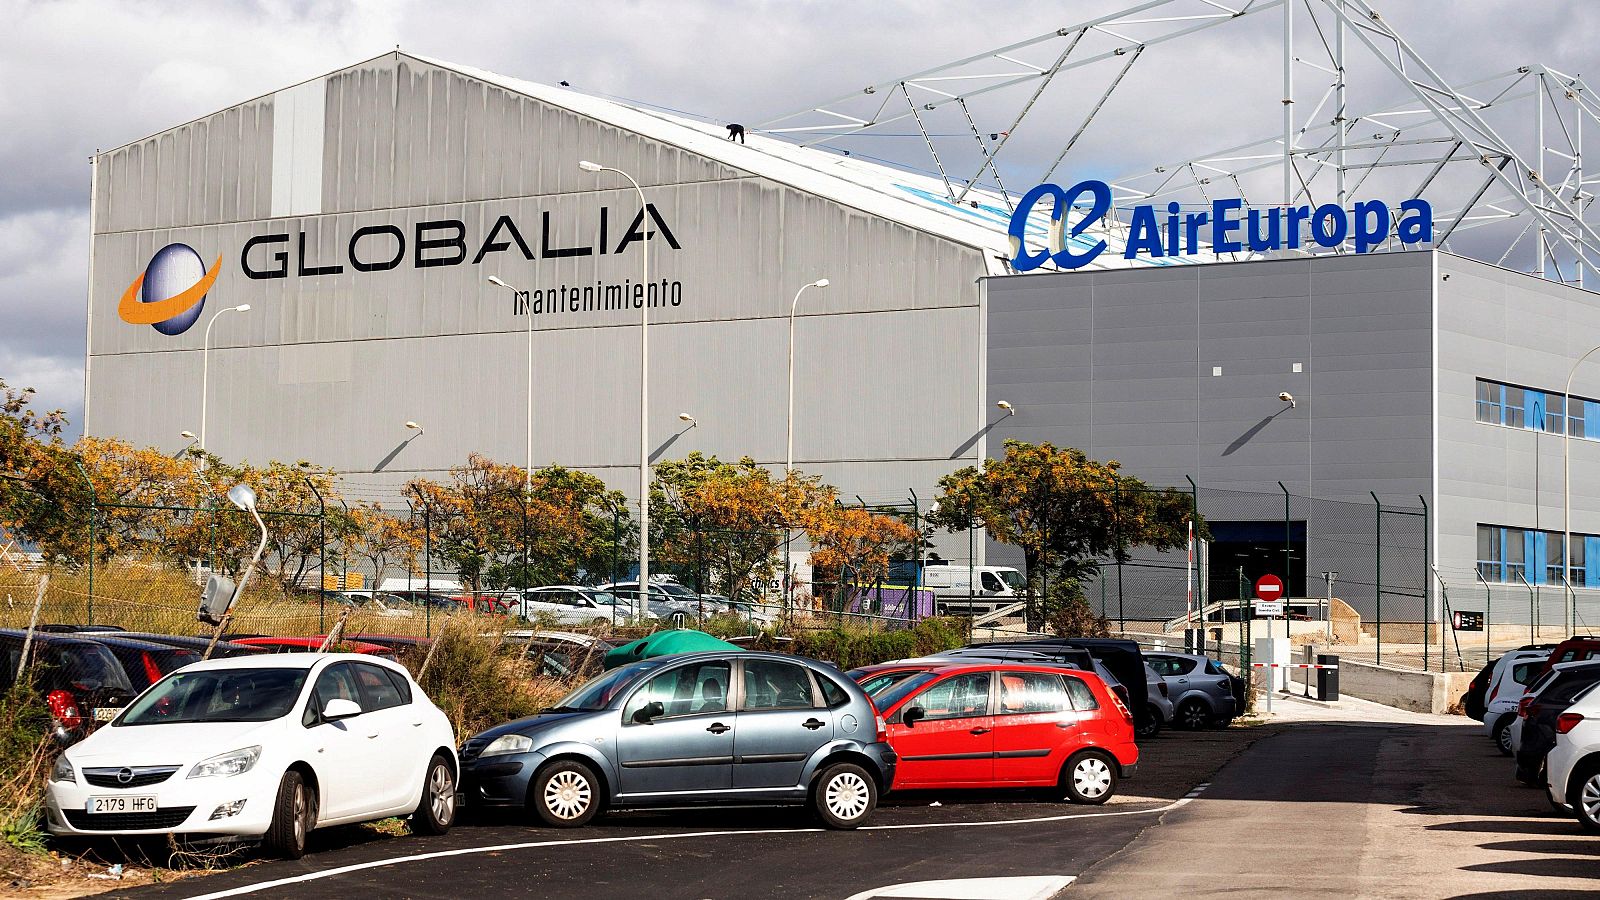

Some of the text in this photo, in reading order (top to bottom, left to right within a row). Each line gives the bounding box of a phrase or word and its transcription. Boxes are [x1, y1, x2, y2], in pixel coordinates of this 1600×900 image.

[240, 203, 682, 280] GLOBALIA
[1124, 198, 1433, 259] AirEuropa
[513, 279, 682, 316] mantenimiento
[95, 797, 155, 812] 2179 HFG
